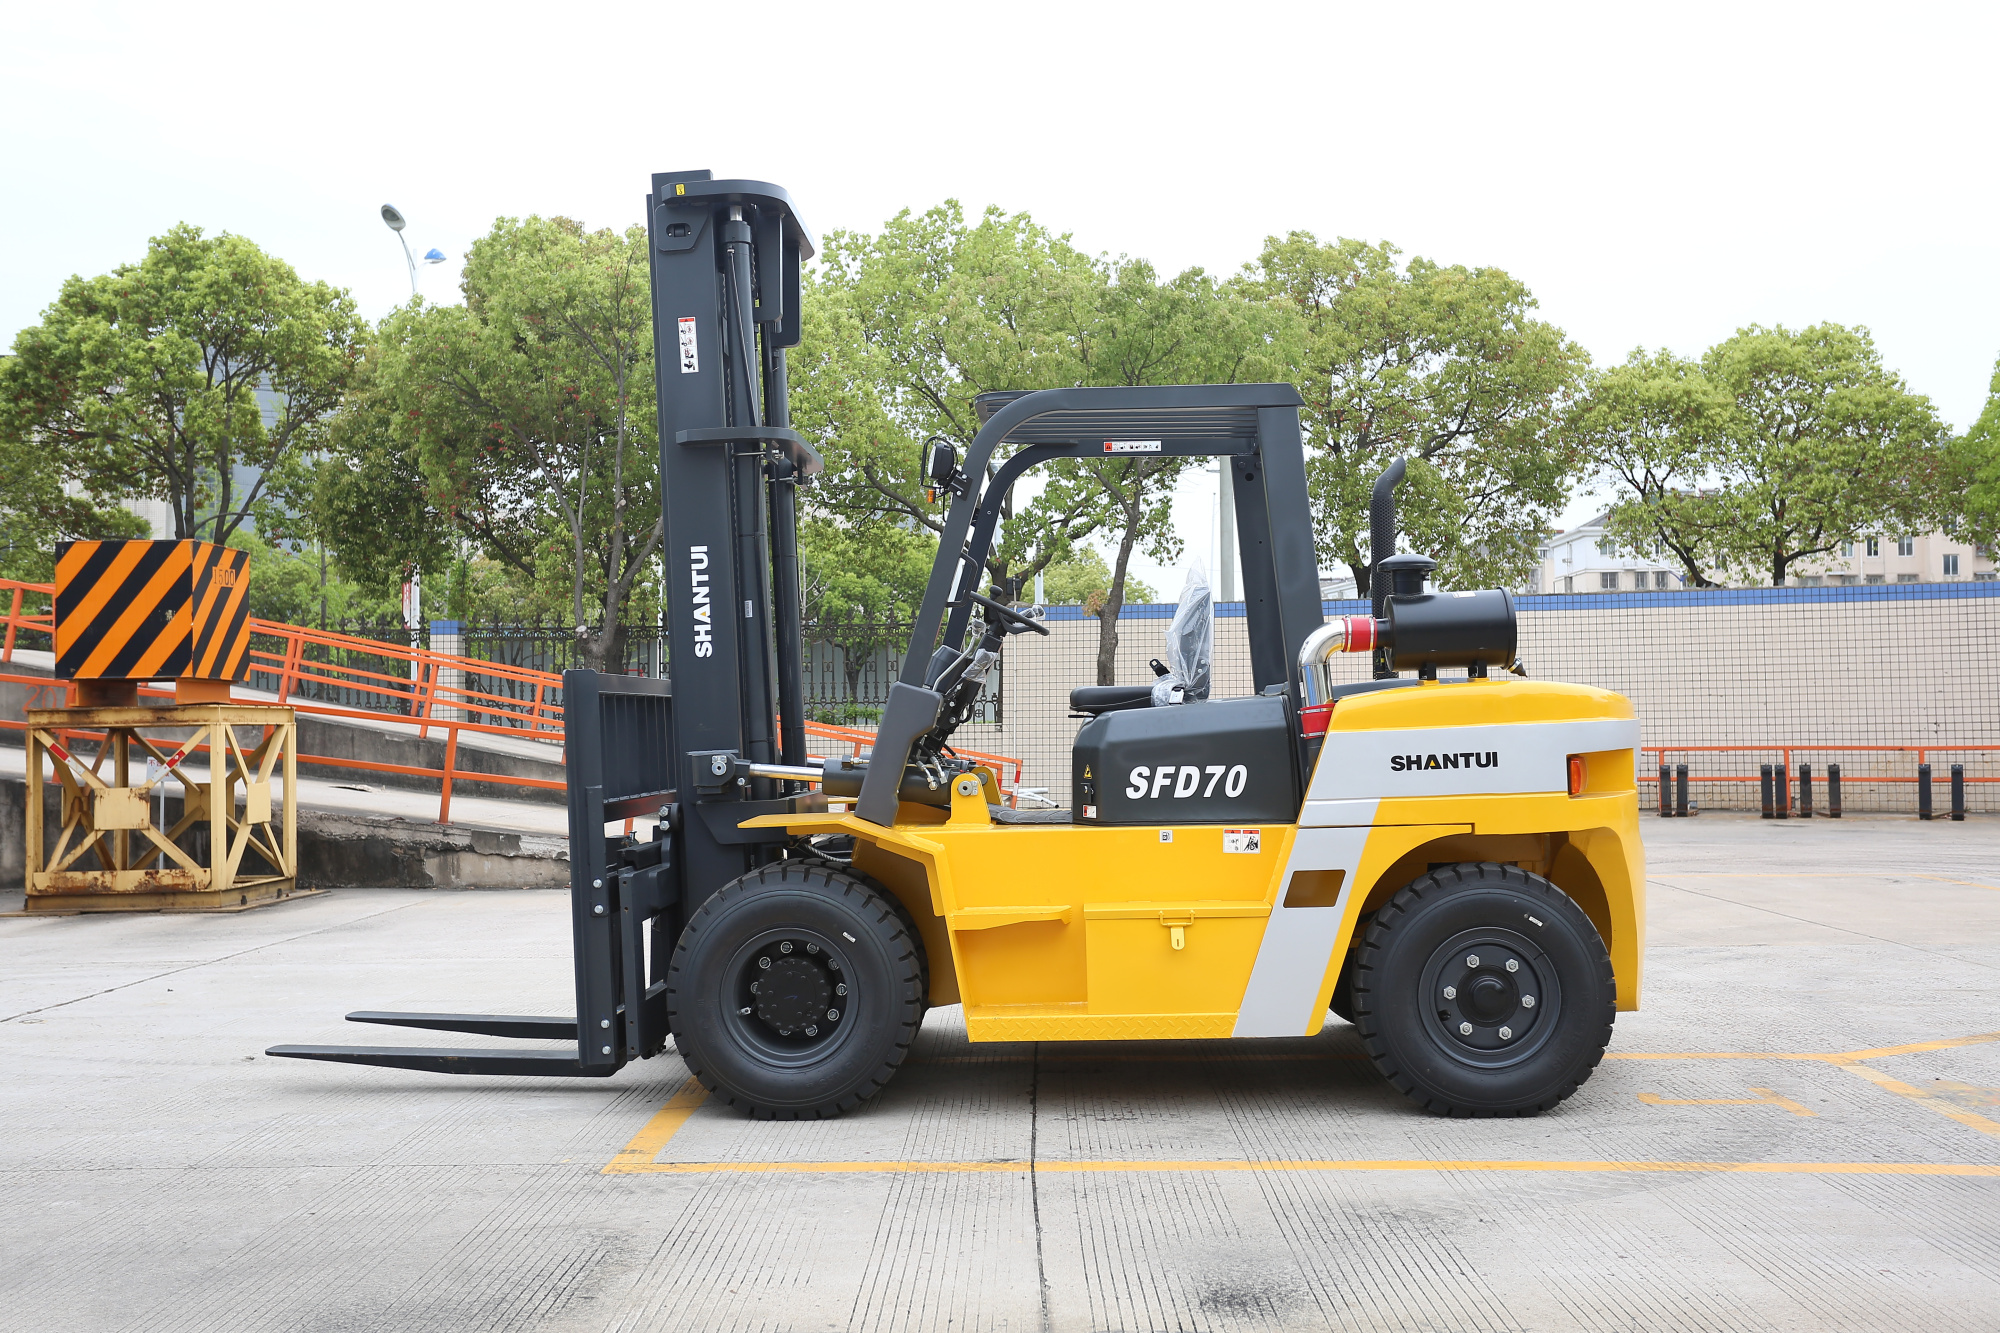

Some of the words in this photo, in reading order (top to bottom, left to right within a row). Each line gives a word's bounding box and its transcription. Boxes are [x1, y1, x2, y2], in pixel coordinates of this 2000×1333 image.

[213, 569, 235, 586] 1500
[690, 545, 713, 658] SHANTUI
[1390, 751, 1499, 772] SHANTUI
[1125, 764, 1249, 800] SFD70
